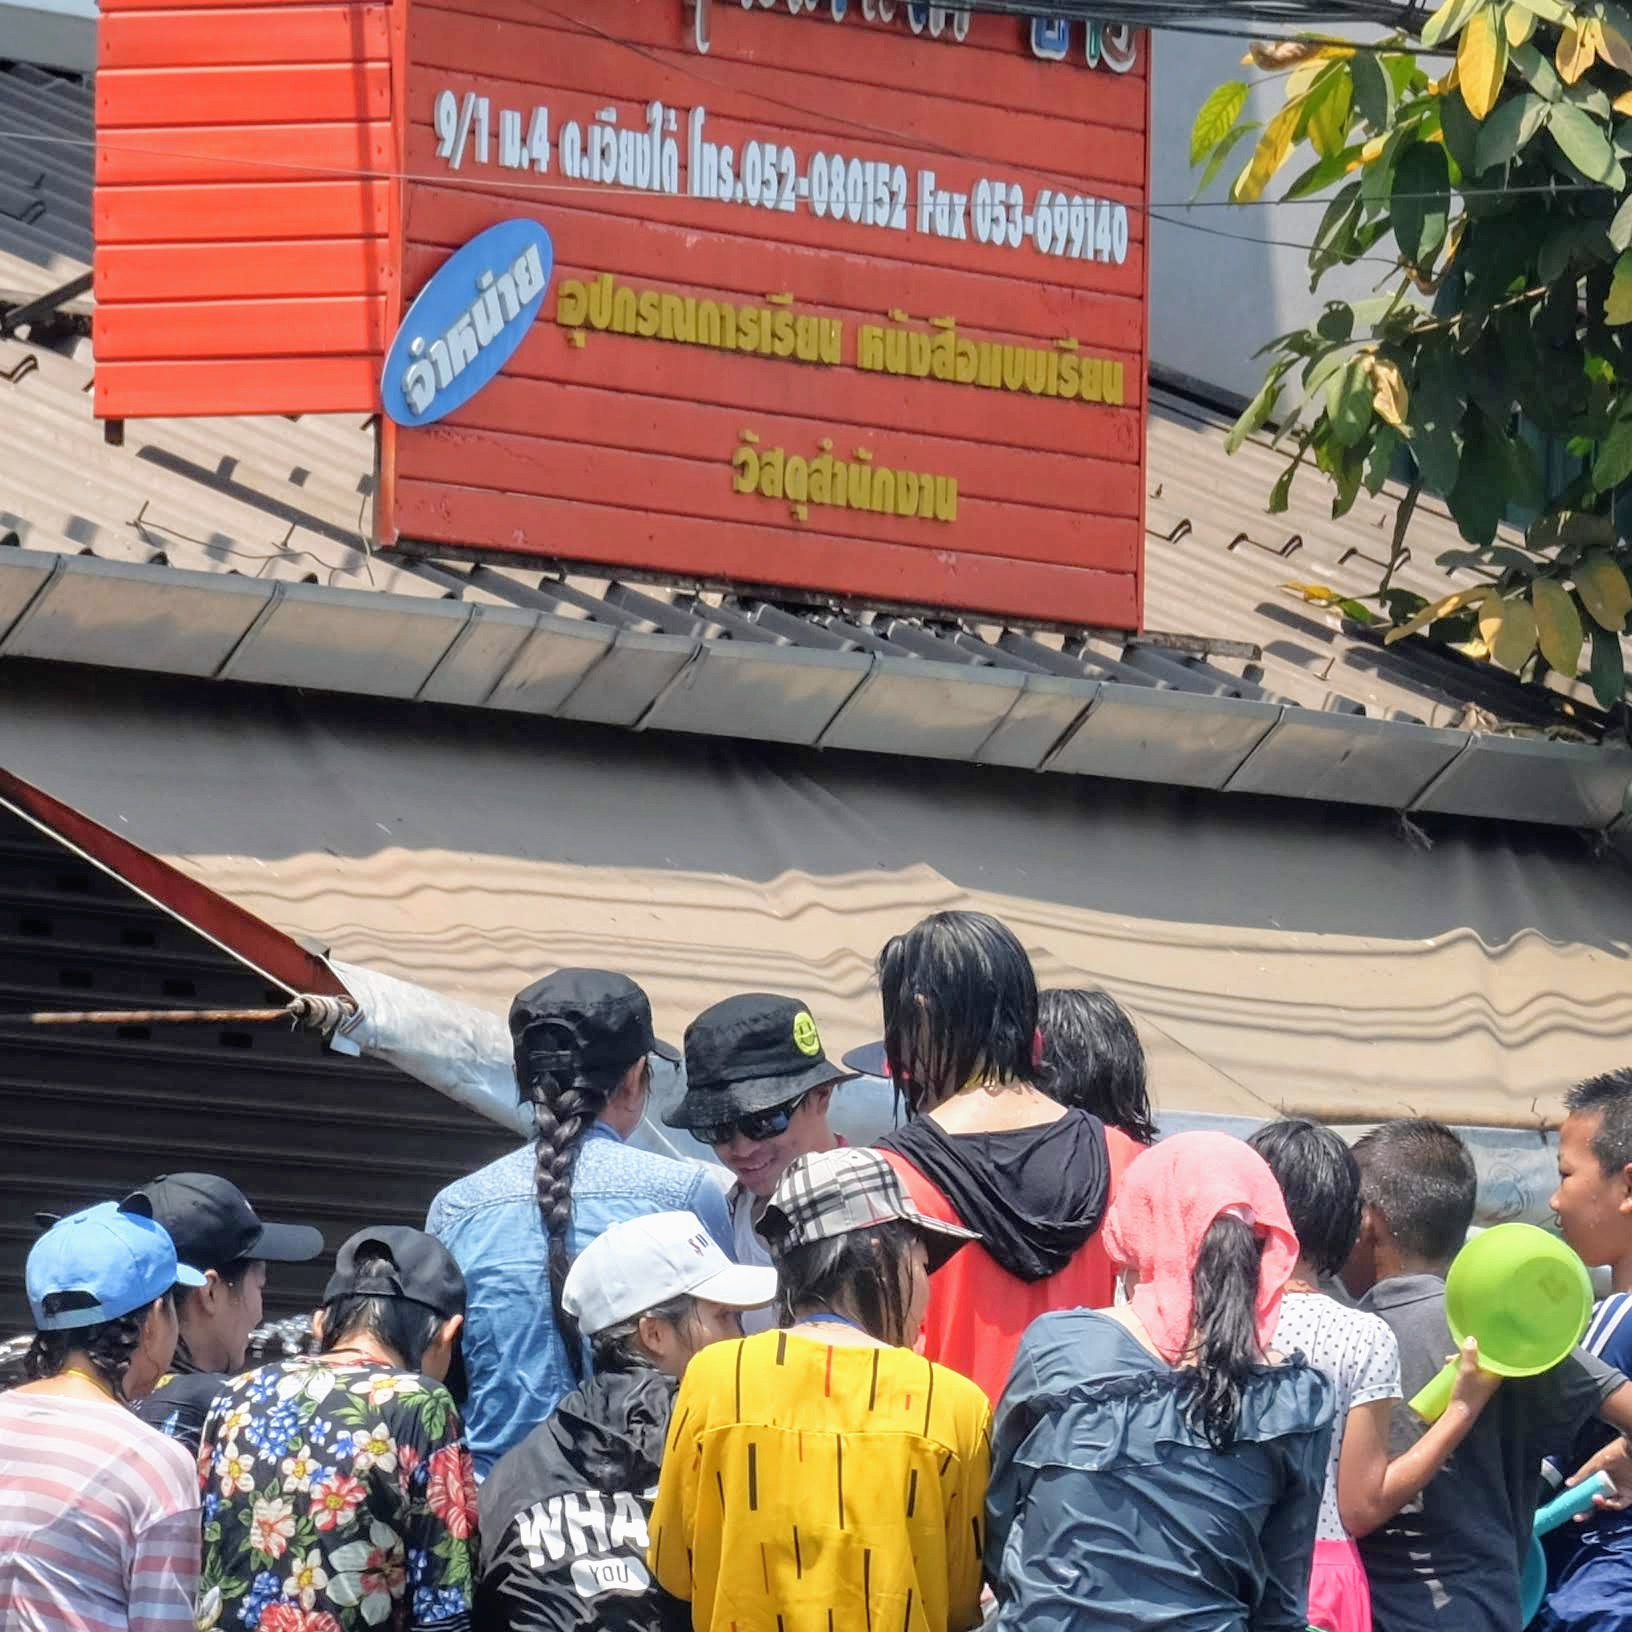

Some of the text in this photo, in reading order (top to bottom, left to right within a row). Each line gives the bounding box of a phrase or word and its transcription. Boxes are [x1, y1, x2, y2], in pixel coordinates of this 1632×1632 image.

[434, 89, 490, 170] 9/1
[498, 106, 550, 173] ม.4
[688, 105, 908, 232] โทร.052-080152
[917, 169, 968, 240] Fax
[971, 177, 1128, 265] 053-699140
[401, 243, 546, 418] จำหน่าย
[857, 308, 1125, 405] หนังสือแบบเรียน
[733, 428, 958, 522] วัสดุสำนักงาน
[515, 1488, 659, 1568] WHA
[589, 1564, 629, 1585] YOU
